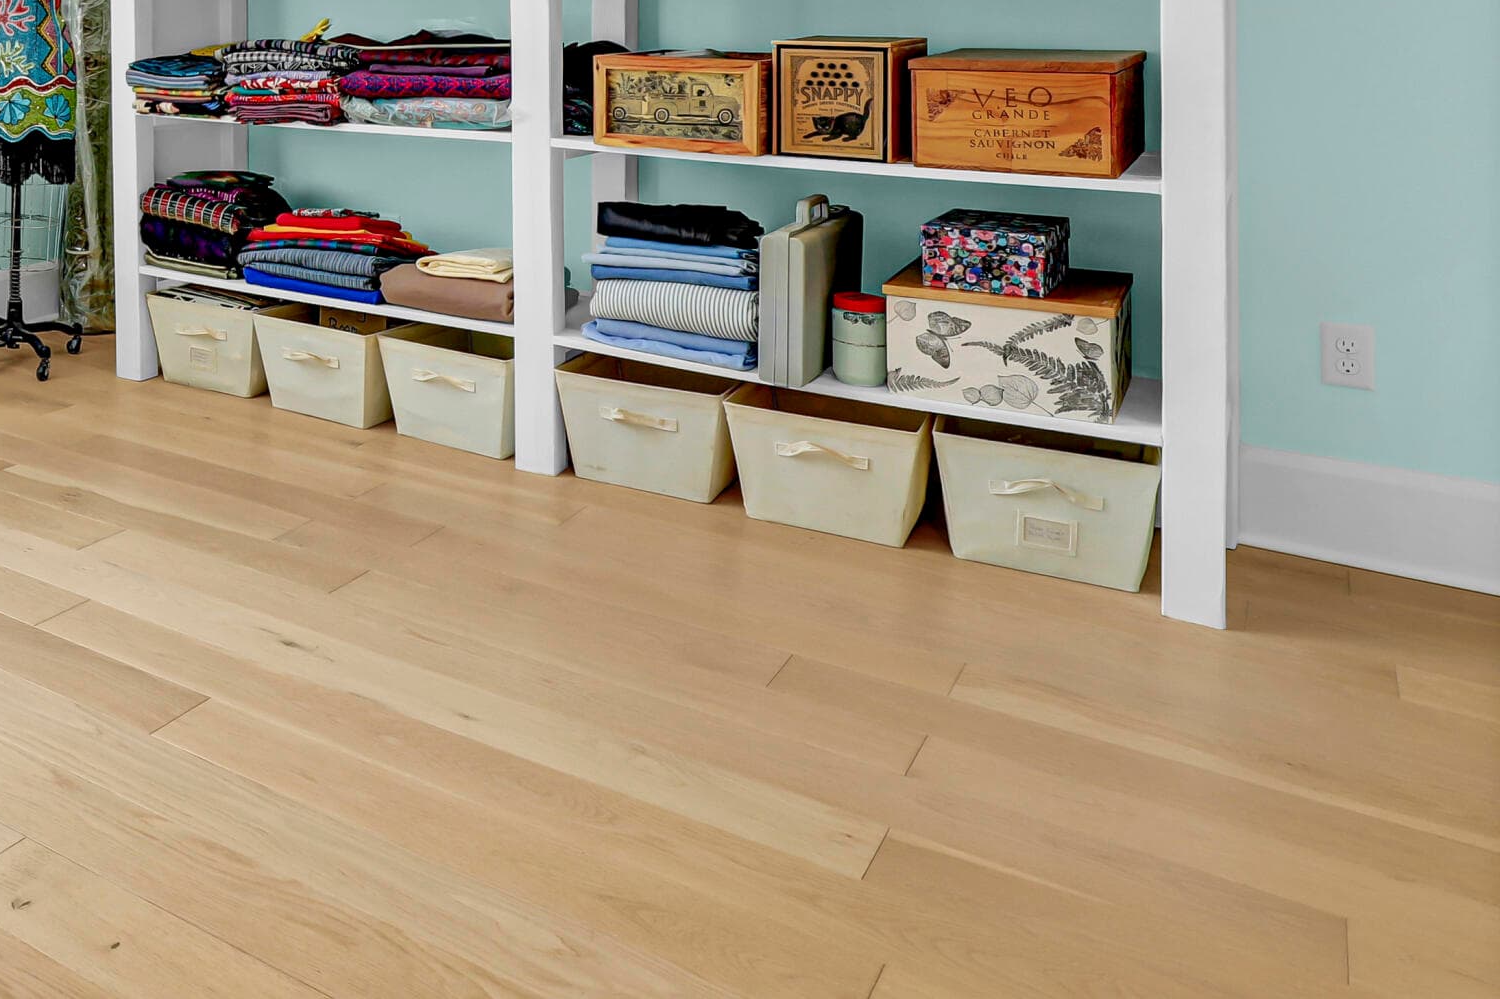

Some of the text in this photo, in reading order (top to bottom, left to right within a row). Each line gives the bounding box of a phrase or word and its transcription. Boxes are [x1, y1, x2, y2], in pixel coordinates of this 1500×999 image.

[800, 86, 864, 106] SNAPPY
[971, 86, 1052, 108] VEO
[971, 109, 1051, 121] GRANDE
[973, 128, 1051, 139] CABERNET
[969, 138, 1056, 150] SAUVIGNON
[995, 152, 1028, 160] CHILE
